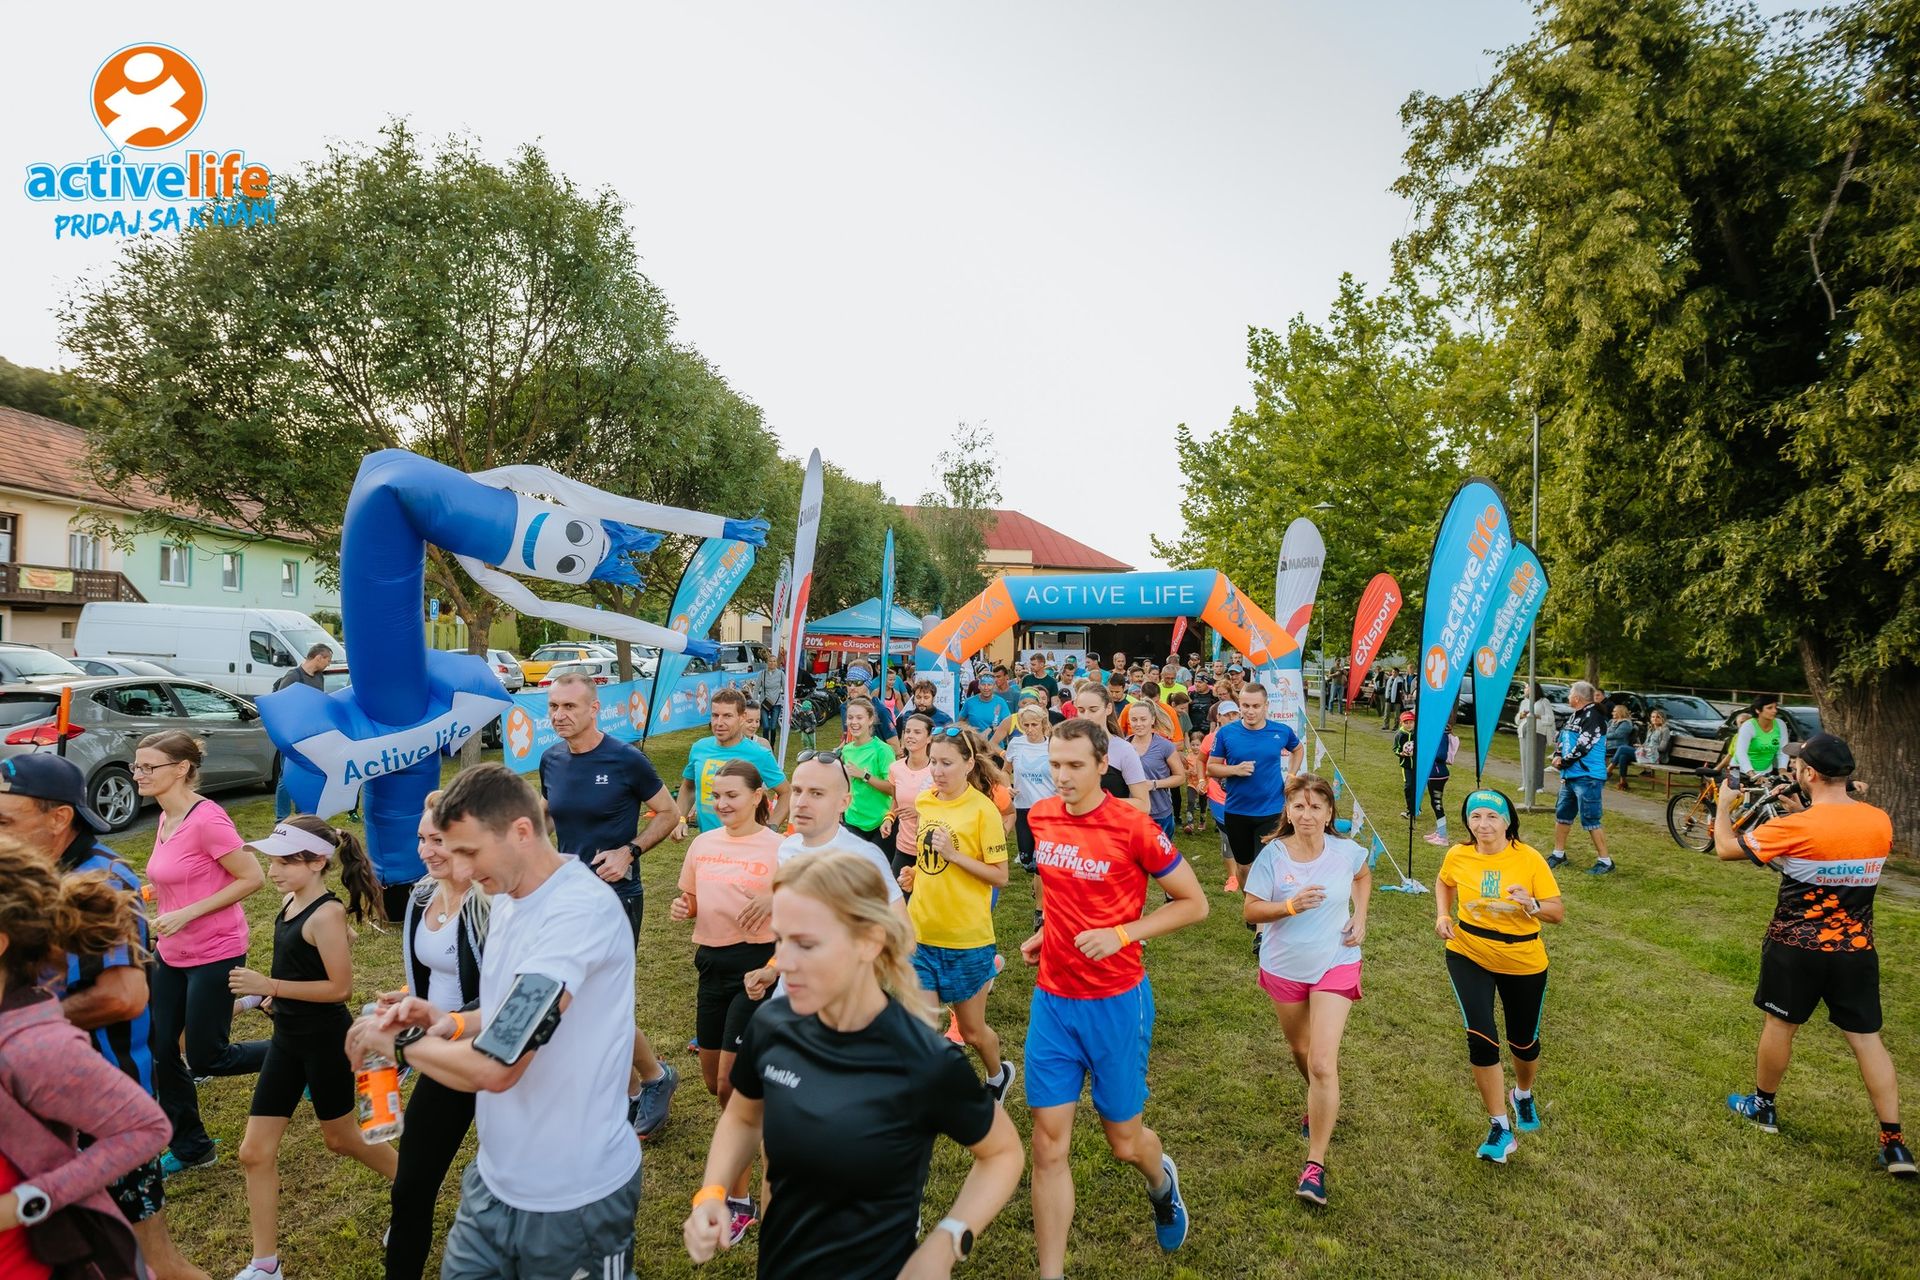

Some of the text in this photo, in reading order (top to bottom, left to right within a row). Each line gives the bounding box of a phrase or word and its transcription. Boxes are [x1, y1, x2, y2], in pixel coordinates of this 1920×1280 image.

[1288, 556, 1320, 570] MAGNA
[1441, 505, 1501, 649] activelife
[1025, 585, 1195, 604] ACTIVE LIFE
[432, 602, 437, 613] P
[693, 599, 716, 633] PRIDAJ
[715, 587, 726, 600] SA
[1488, 561, 1536, 653] activelife
[1451, 616, 1475, 670] PRIDAJ
[1472, 594, 1485, 616] SA
[1480, 577, 1491, 592] K
[805, 637, 824, 646] 20%
[1500, 635, 1518, 668] PRIDAJ
[1515, 616, 1526, 631] SA
[1521, 604, 1530, 616] K
[344, 721, 471, 785] Active life
[1038, 840, 1079, 857] WE ARE
[1035, 851, 1111, 874] TRIATHLON
[1816, 861, 1881, 875] activelife
